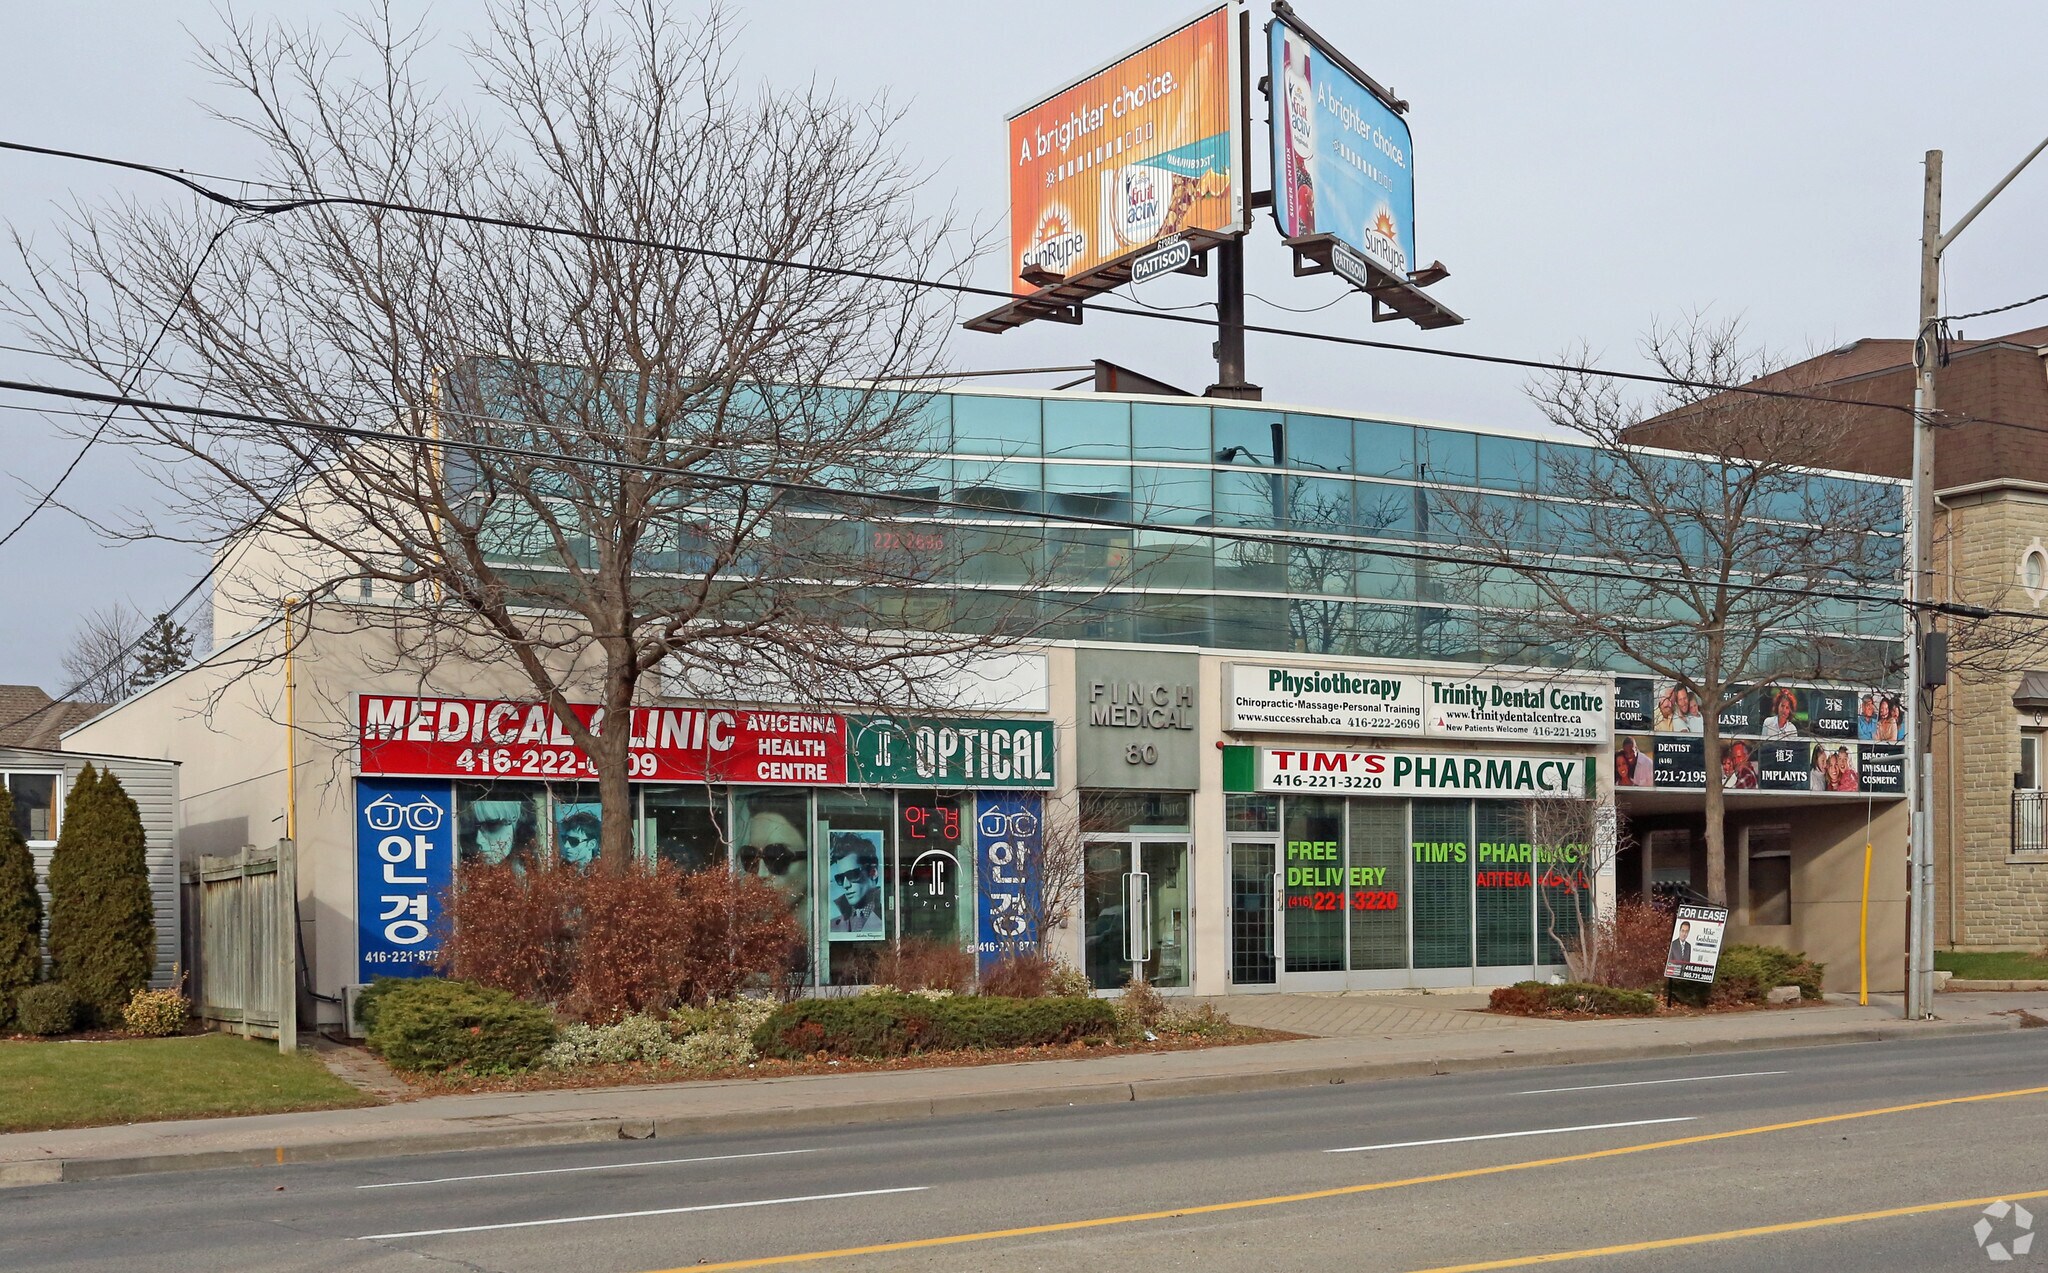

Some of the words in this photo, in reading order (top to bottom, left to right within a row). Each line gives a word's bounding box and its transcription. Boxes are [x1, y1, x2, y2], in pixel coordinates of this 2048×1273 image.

[1019, 137, 1032, 166] A
[1036, 101, 1109, 158] brighter
[1112, 70, 1178, 120] choice.
[1317, 81, 1327, 107] A
[1328, 84, 1371, 140] brighter
[1372, 120, 1406, 169] choice.
[1131, 183, 1155, 206] fruit
[1022, 231, 1084, 271] SunRype
[1365, 227, 1405, 275] SunRype
[1136, 246, 1186, 279] PATTISON
[1335, 249, 1365, 282] PATTISON
[1088, 680, 1194, 708] FINCH
[1269, 669, 1402, 701] Physiotherapy
[1431, 681, 1488, 710] Trinity
[1491, 685, 1545, 709] Dental
[1550, 688, 1603, 711] Centre
[1088, 706, 1194, 730] MEDICAL
[1384, 703, 1421, 716] Training
[1446, 708, 1582, 724] www.trinitydentalcentre.ca
[1718, 714, 1749, 726] LASER
[365, 698, 575, 747] MEDICAL
[746, 713, 838, 734] AVICENNA
[1237, 713, 1341, 726] www.successrehab.ca
[1347, 717, 1421, 730] 416-222-2696
[1446, 723, 1463, 732] New
[1464, 724, 1495, 733] Patients
[1495, 725, 1529, 734] Welcome
[1532, 726, 1597, 738] 416-221-2195
[1818, 718, 1850, 730] CEREC
[758, 738, 826, 757] HEALTH
[875, 730, 892, 767] JC
[915, 726, 1051, 781] OPTICAL
[1124, 742, 1159, 766] 80
[1658, 743, 1691, 753] DENTIST
[1775, 749, 1794, 763] 植牙
[456, 748, 659, 777] 416-222-09
[757, 761, 828, 781] CENTRE
[1271, 750, 1386, 774] TIM'S
[1393, 756, 1576, 791] PHARMACY
[1658, 757, 1673, 765] (416)
[1862, 764, 1901, 773] INVISALIGN
[1272, 773, 1382, 789] 416-221-3220
[1654, 770, 1707, 783] 221-2195
[1761, 770, 1808, 782] IMPLANTS
[1862, 776, 1898, 785] COSMETIC
[1141, 801, 1186, 817] CLINIC
[905, 806, 960, 840] 안경
[1287, 841, 1338, 861] FREE
[1412, 842, 1467, 863] TIM'S
[1479, 842, 1591, 864] PHARMACY
[929, 861, 944, 896] JC
[1287, 867, 1387, 887] DELIVERY
[377, 834, 434, 945] 안경
[988, 841, 1031, 936] 안경
[1288, 895, 1313, 909] (416)
[1313, 890, 1399, 911] 221-3220
[1678, 907, 1697, 919] FOR
[1697, 909, 1726, 921] LEASE
[364, 950, 440, 963] 416-221-877
